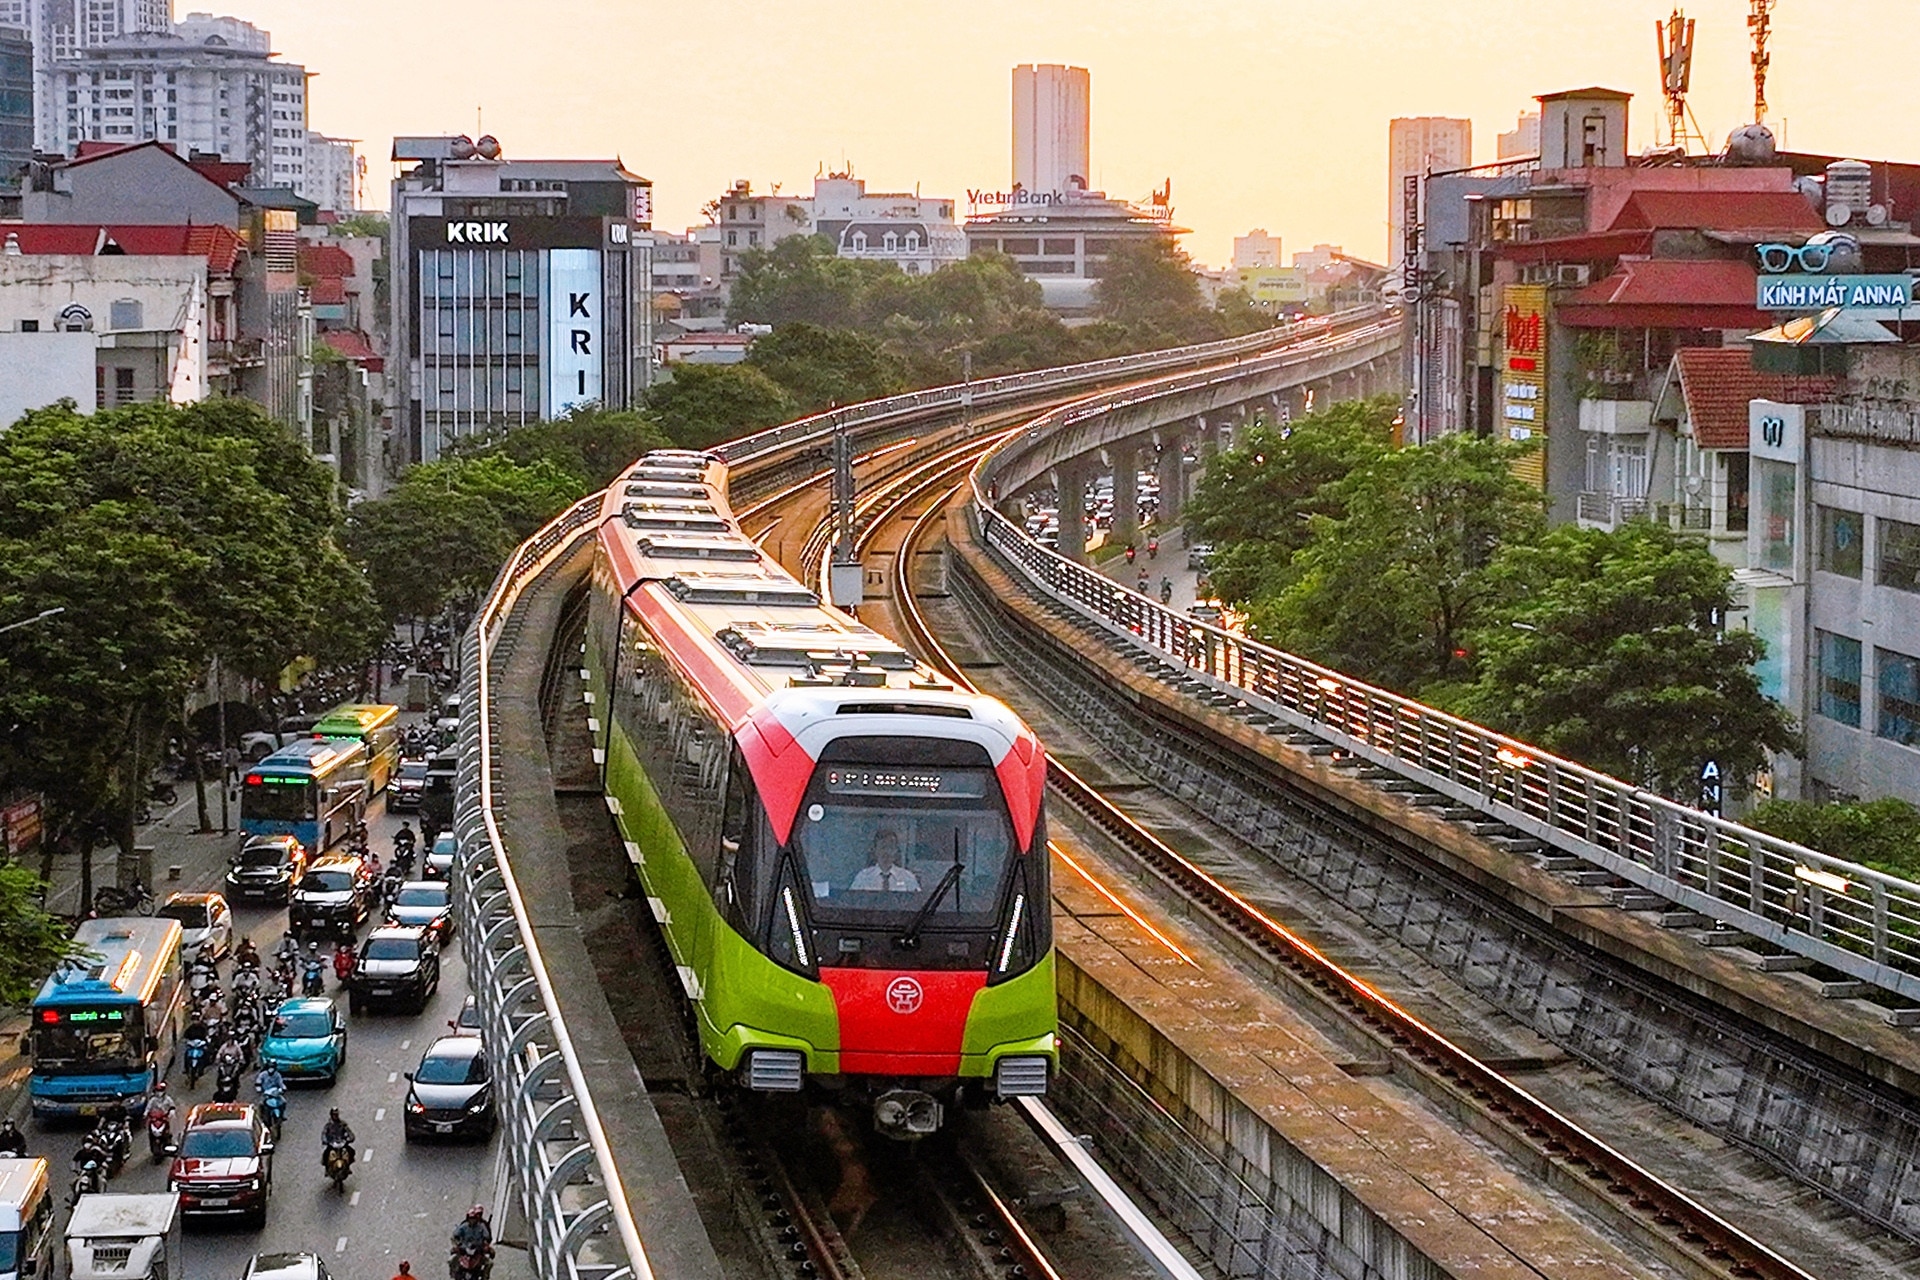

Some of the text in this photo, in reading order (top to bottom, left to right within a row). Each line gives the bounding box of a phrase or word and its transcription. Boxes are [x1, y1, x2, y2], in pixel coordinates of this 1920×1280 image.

[966, 188, 1064, 205] VietinBank
[447, 222, 510, 243] KRIK
[610, 224, 628, 244] KRIK
[1405, 177, 1418, 289] EYEPLUS
[1762, 277, 1905, 305] KÍNH MẮT ANNA
